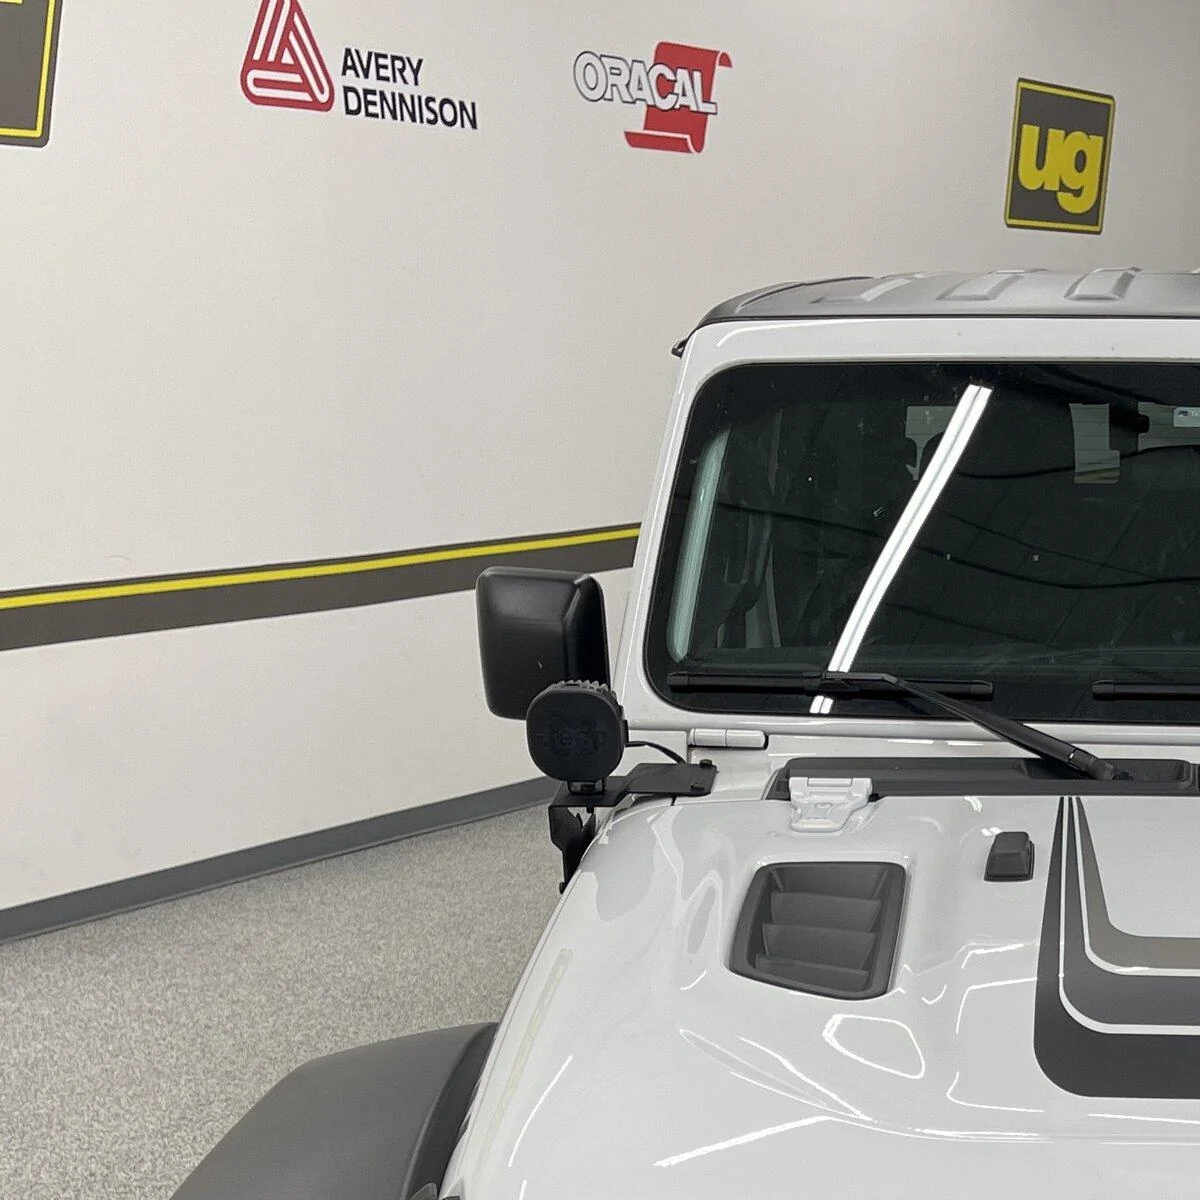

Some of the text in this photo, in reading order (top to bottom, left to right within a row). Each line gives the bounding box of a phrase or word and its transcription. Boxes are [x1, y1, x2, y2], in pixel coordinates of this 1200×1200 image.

[341, 48, 423, 86] AVERY
[574, 51, 718, 115] ORACAL
[342, 85, 478, 130] DENNISON
[1018, 124, 1104, 214] ug
